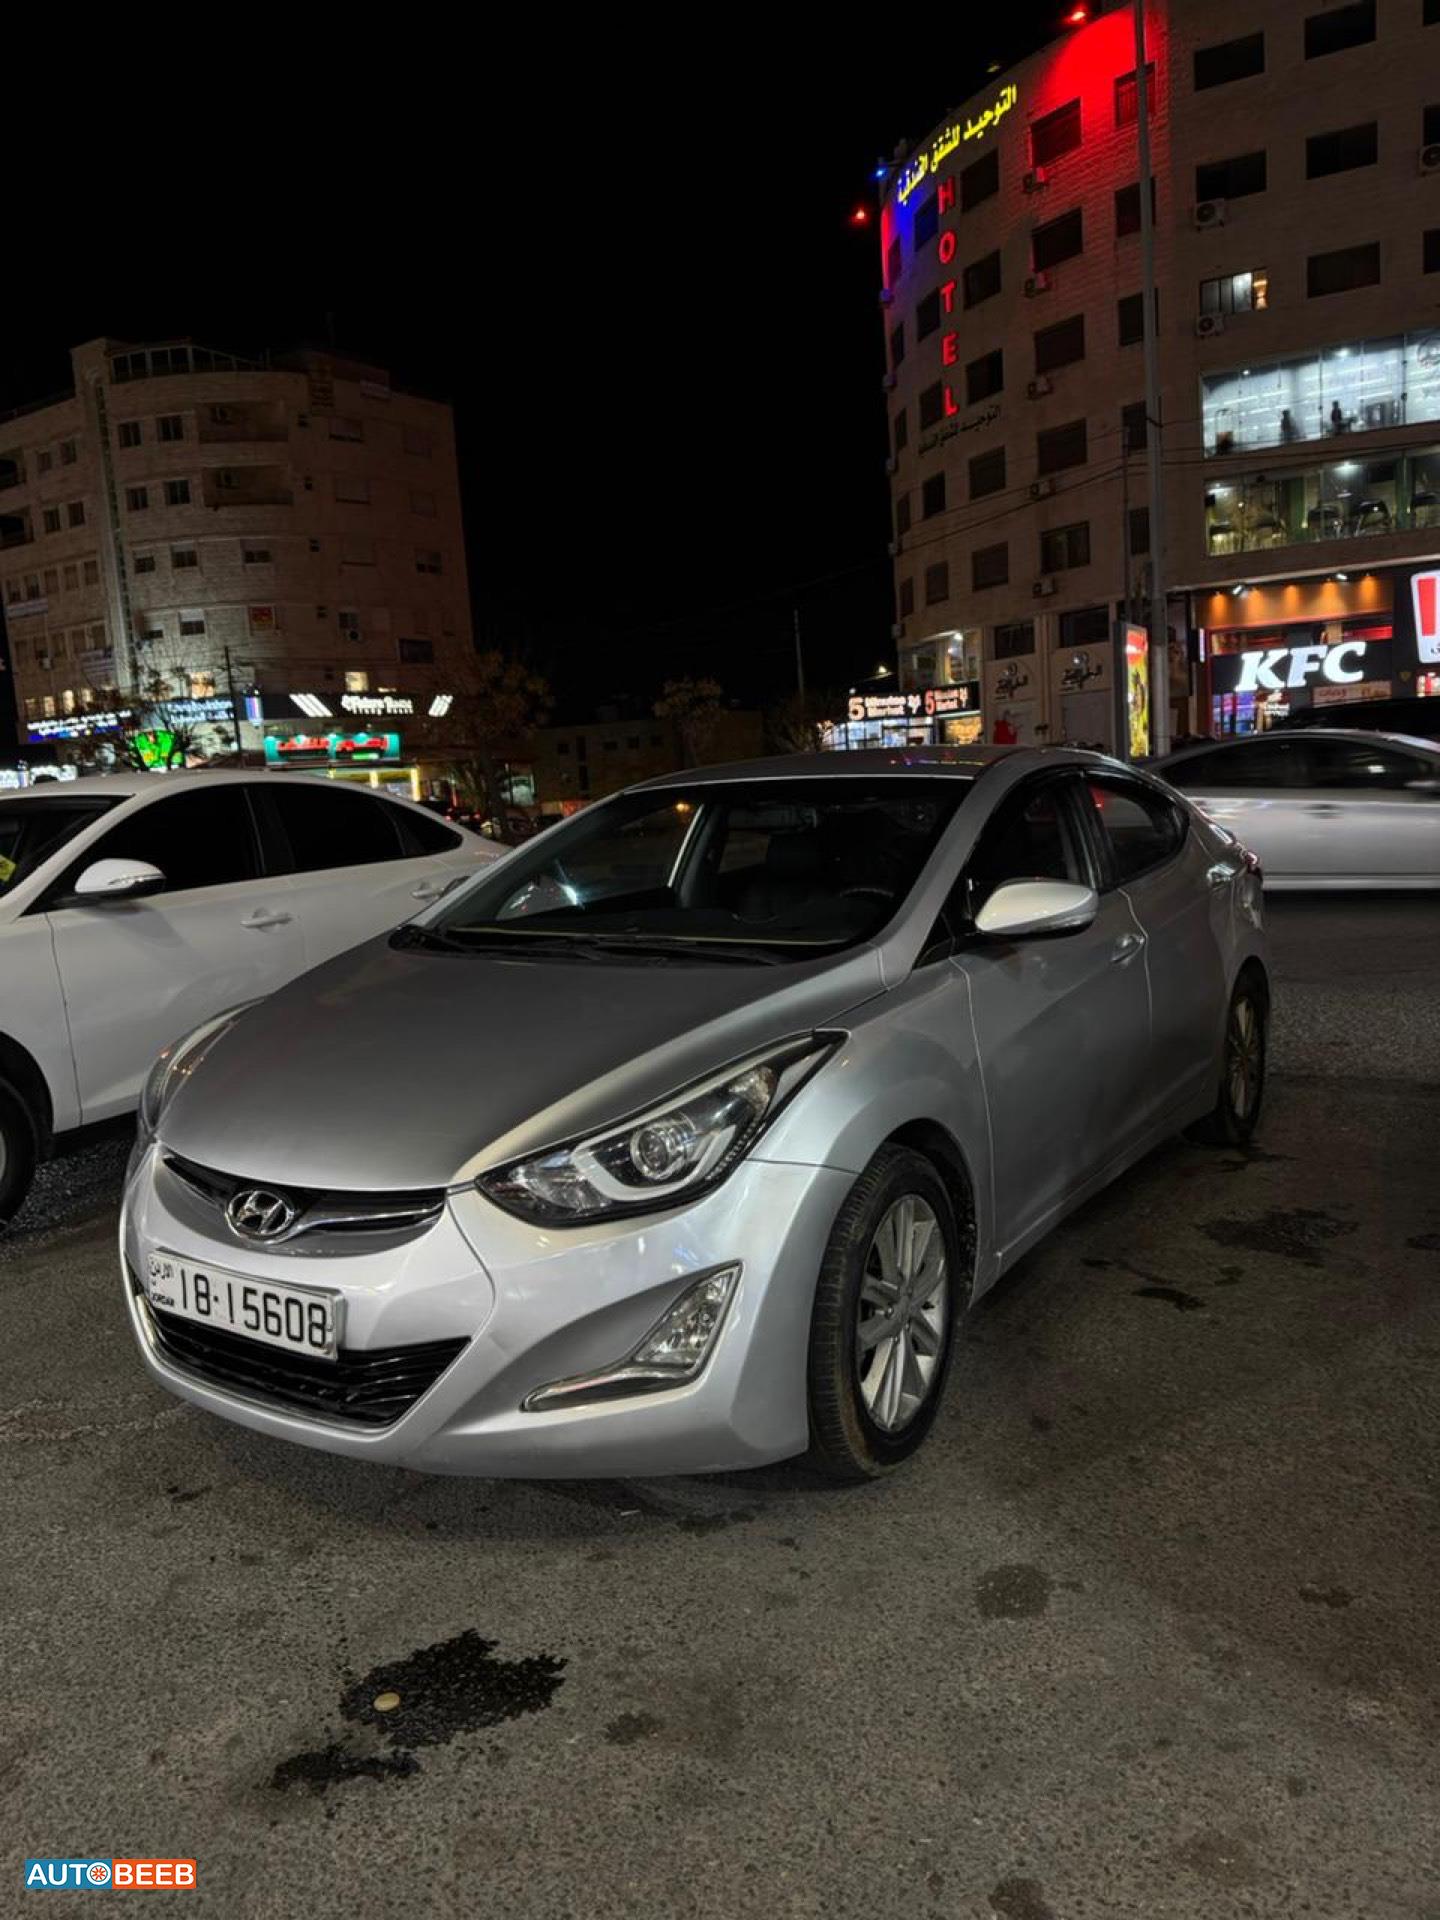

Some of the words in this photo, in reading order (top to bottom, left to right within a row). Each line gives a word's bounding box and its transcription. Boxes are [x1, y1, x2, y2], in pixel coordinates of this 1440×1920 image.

[963, 84, 1017, 140] التوحيد
[937, 175, 960, 417] HOTEL
[1234, 641, 1367, 692] KFC
[848, 697, 865, 721] 5
